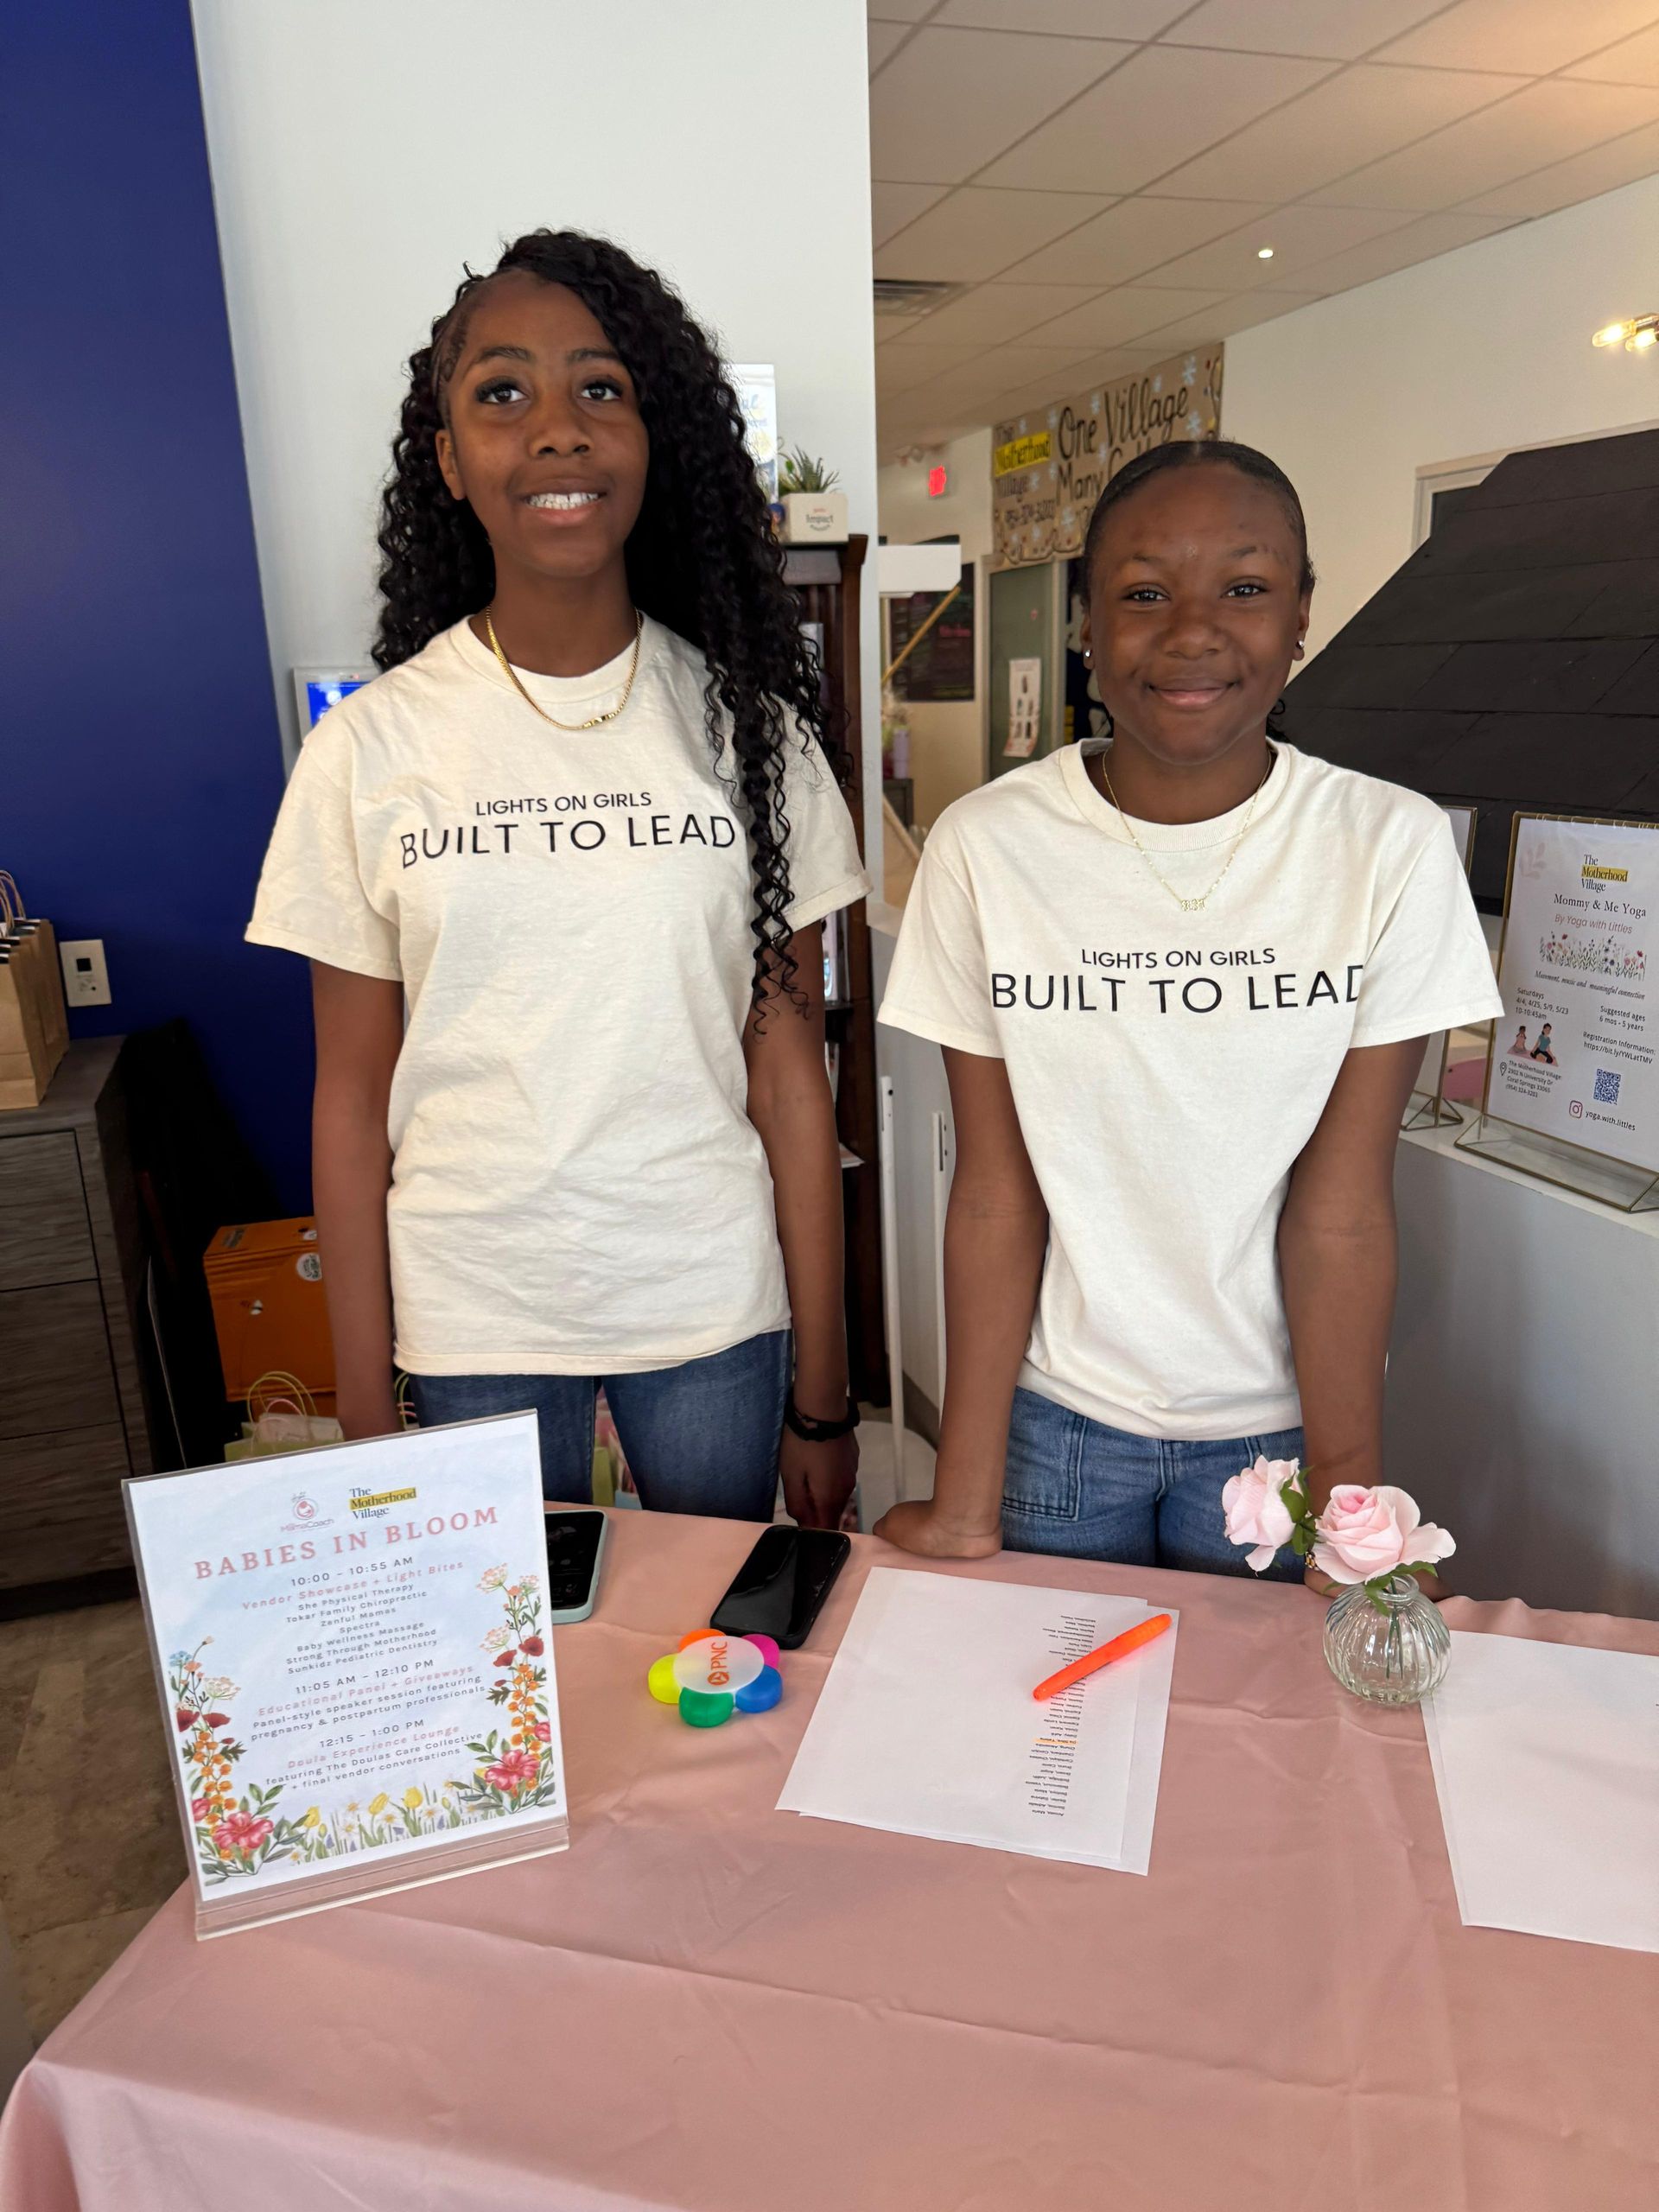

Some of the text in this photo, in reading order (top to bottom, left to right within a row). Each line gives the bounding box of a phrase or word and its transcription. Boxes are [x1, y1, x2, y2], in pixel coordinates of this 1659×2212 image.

[1058, 407, 1096, 461] One
[1104, 378, 1189, 448] Village
[475, 792, 652, 816] LIGHTS ON GIRLS
[400, 814, 735, 868] BUILT TO LEAD
[1581, 867, 1628, 881] Motherhood
[1584, 855, 1599, 865] The
[1581, 879, 1605, 893] Village
[1554, 893, 1646, 919] Mommy & Me Yoga
[1555, 914, 1632, 933] By Yoga with Littles
[1082, 948, 1275, 969] LIGHTS ON GIRLS
[992, 973, 1125, 1012] BUILT
[1148, 977, 1222, 1014] TO
[1517, 988, 1544, 1000] Saturdays
[1600, 1006, 1630, 1018] Suggested
[1627, 1022, 1643, 1031] years
[1583, 1031, 1656, 1055] Registration Information:
[1518, 1063, 1545, 1075] Motherhood
[1546, 1071, 1561, 1080] Village
[1586, 1110, 1636, 1131] yoga.with.littles
[350, 1488, 372, 1497] The
[351, 1489, 416, 1509] Motherhood
[353, 1507, 389, 1519] Village
[194, 1506, 499, 1579] BABIES IN BLOOM
[291, 1573, 330, 1586] 10:00
[349, 1561, 387, 1576] 10:55
[394, 1556, 414, 1568] AM
[242, 1594, 292, 1611] Vendor
[299, 1579, 366, 1599] Showcase
[387, 1569, 423, 1585] Light
[429, 1562, 464, 1573] Bites
[298, 1583, 414, 1611] She Physical Therapy
[287, 1591, 427, 1623] Tokar Family Chiropractic
[321, 1608, 397, 1626] Zenful Mamas
[297, 1622, 424, 1652] Baby Wellness Massage
[340, 1621, 380, 1633] Spectra
[287, 1629, 436, 1664] Strong Through Motherhood
[289, 1639, 437, 1674] Sunkidz Pediatric Dentistry
[711, 1641, 728, 1669] PNC
[258, 1691, 342, 1716] Educational
[348, 1683, 385, 1697] Panel
[404, 1666, 474, 1685] Giveaways
[296, 1682, 330, 1694] 11:05
[337, 1675, 356, 1686] AM
[376, 1665, 409, 1678] 12:10
[415, 1660, 433, 1669] PM
[251, 1723, 313, 1741] pregnancy
[333, 1704, 401, 1725] postpartum
[406, 1685, 485, 1709] professionals
[253, 1675, 481, 1728] Panel-style speaker session featuring
[320, 1734, 353, 1747] 12:15
[372, 1725, 399, 1737] 1:00
[406, 1719, 424, 1729] PM
[266, 1732, 482, 1785] featuring The Doulas Care Collective
[288, 1726, 459, 1769] Doula Experience Lounge
[302, 1776, 330, 1787] final
[335, 1767, 375, 1780] vendor
[378, 1749, 461, 1770] conversations
